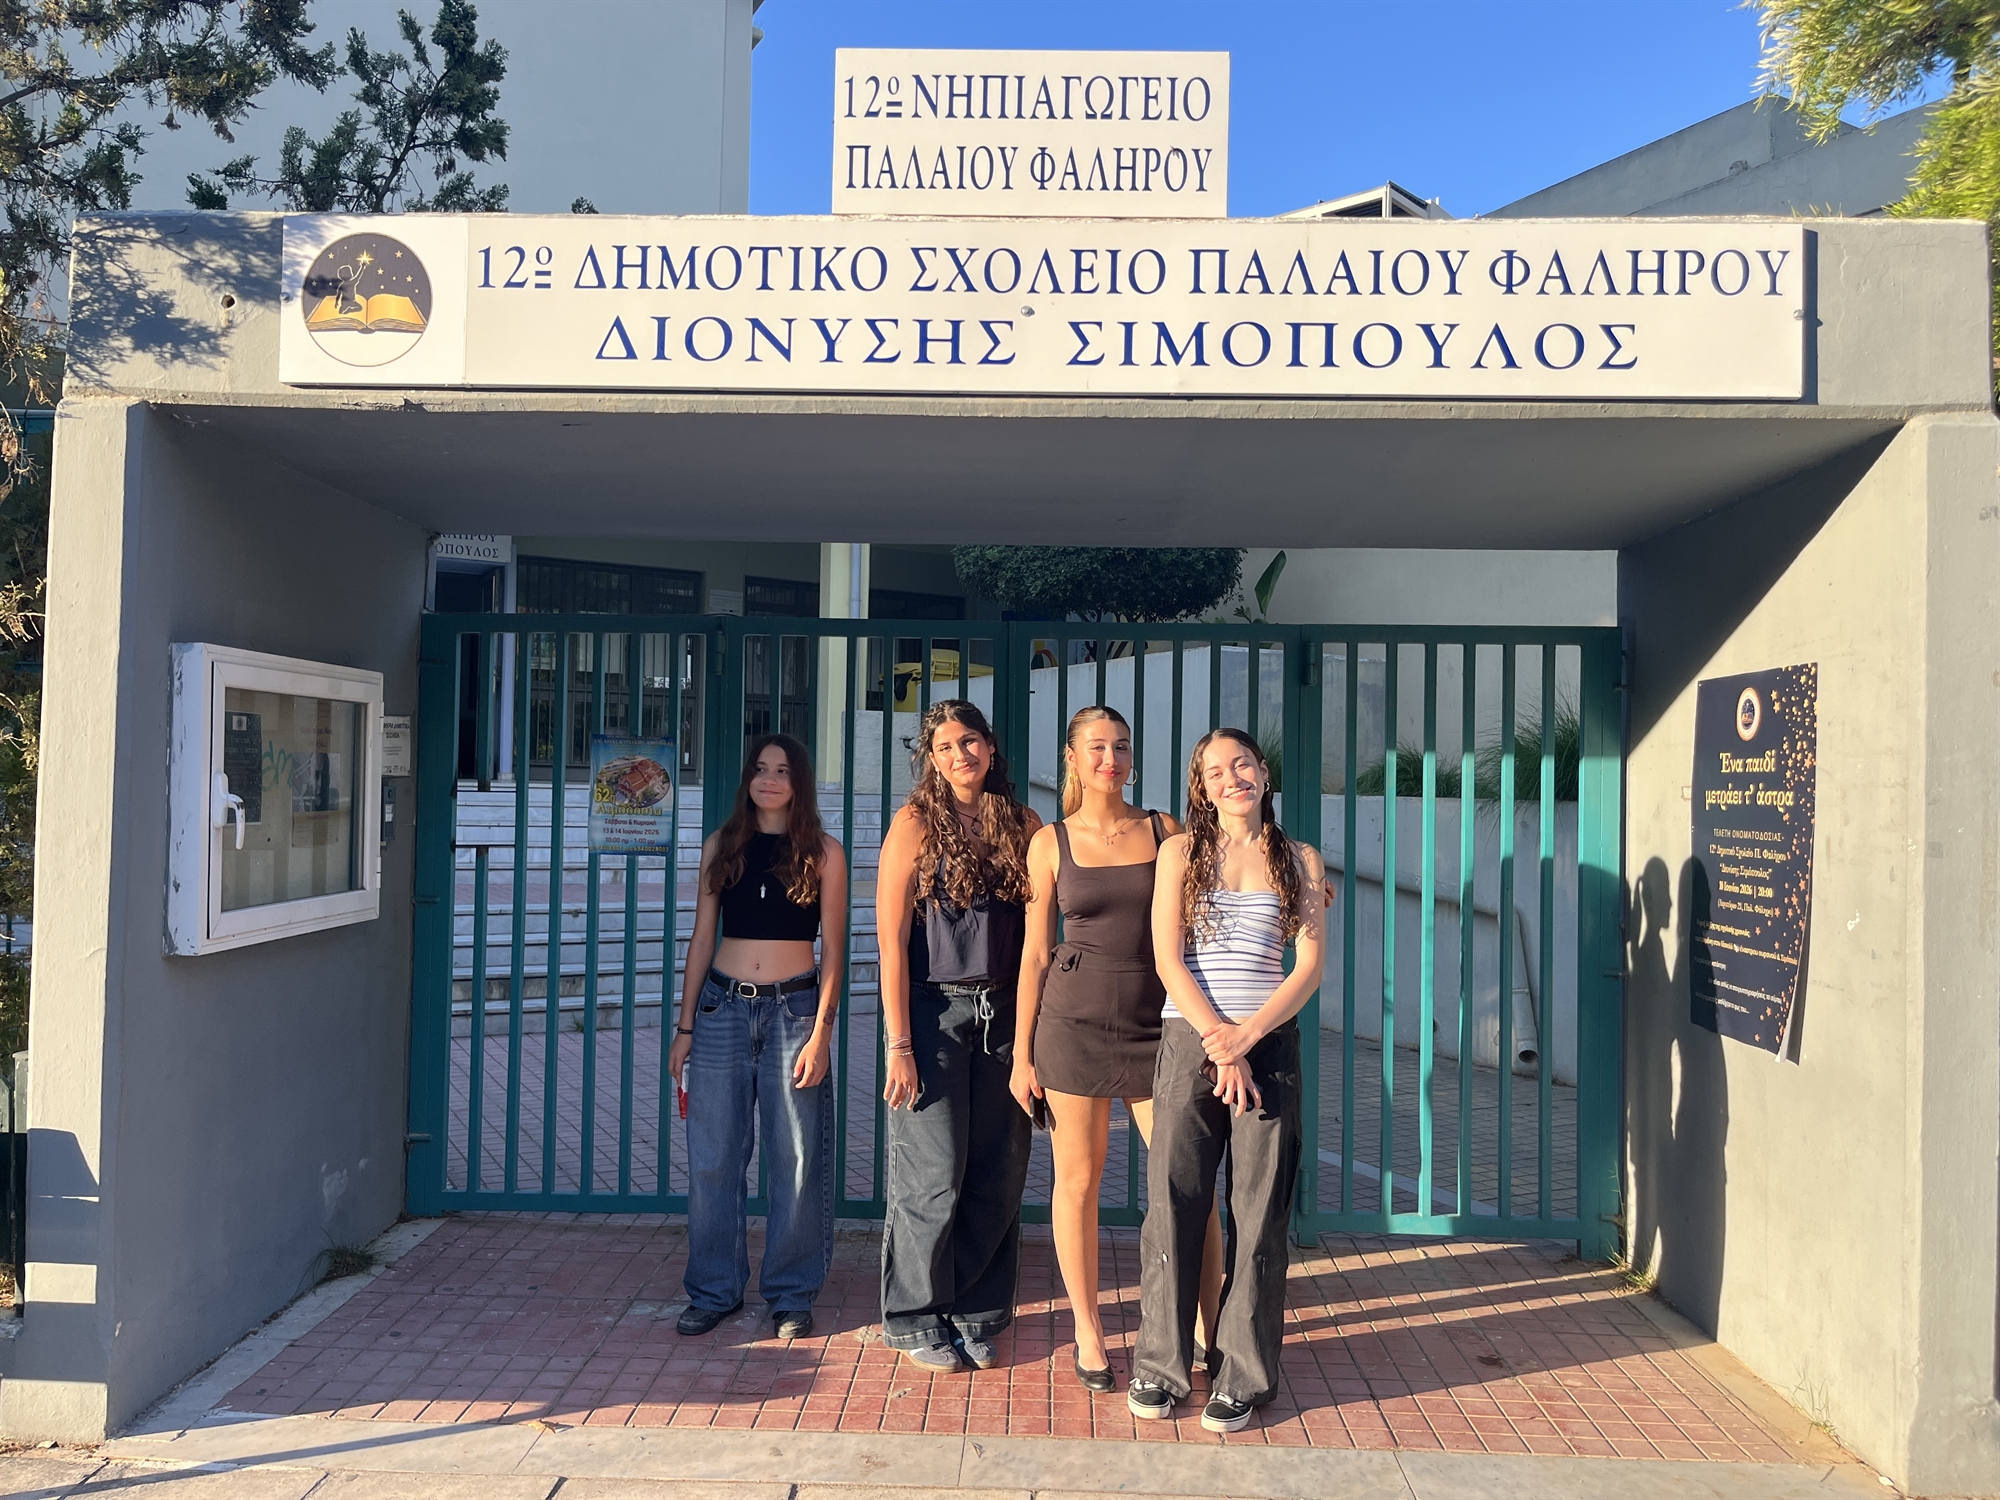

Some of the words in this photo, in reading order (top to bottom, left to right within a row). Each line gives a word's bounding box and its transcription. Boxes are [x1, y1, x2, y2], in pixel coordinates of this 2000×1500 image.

[911, 74, 1211, 121] ΝΗΠΙΑΓΩΓΕΙΟ
[845, 145, 1018, 191] ΠΑΛΑΙΟΥ
[1029, 146, 1212, 192] ΦΑΛΗΡΟΥ
[574, 244, 888, 292] ΔΗΜΟΤΙΚΟ
[908, 246, 1166, 295] ΣΧΟΛΕΙΟ
[1188, 248, 1469, 296] ΠΑΛΑΙΟΥ
[1488, 248, 1790, 297] ΦΑΛΗΡΟΥ
[595, 315, 1016, 366] ΔΙΟΝΥΣΗΣ
[1065, 320, 1639, 371] ΣΙΜΟΠΟΥΛΟΣ
[1719, 752, 1743, 773] Ένα
[1745, 749, 1776, 773] παιδί
[1705, 782, 1742, 811] μετράει
[1756, 782, 1794, 813] άστρα
[1713, 828, 1731, 838] ΤΕΛΕΤΗ
